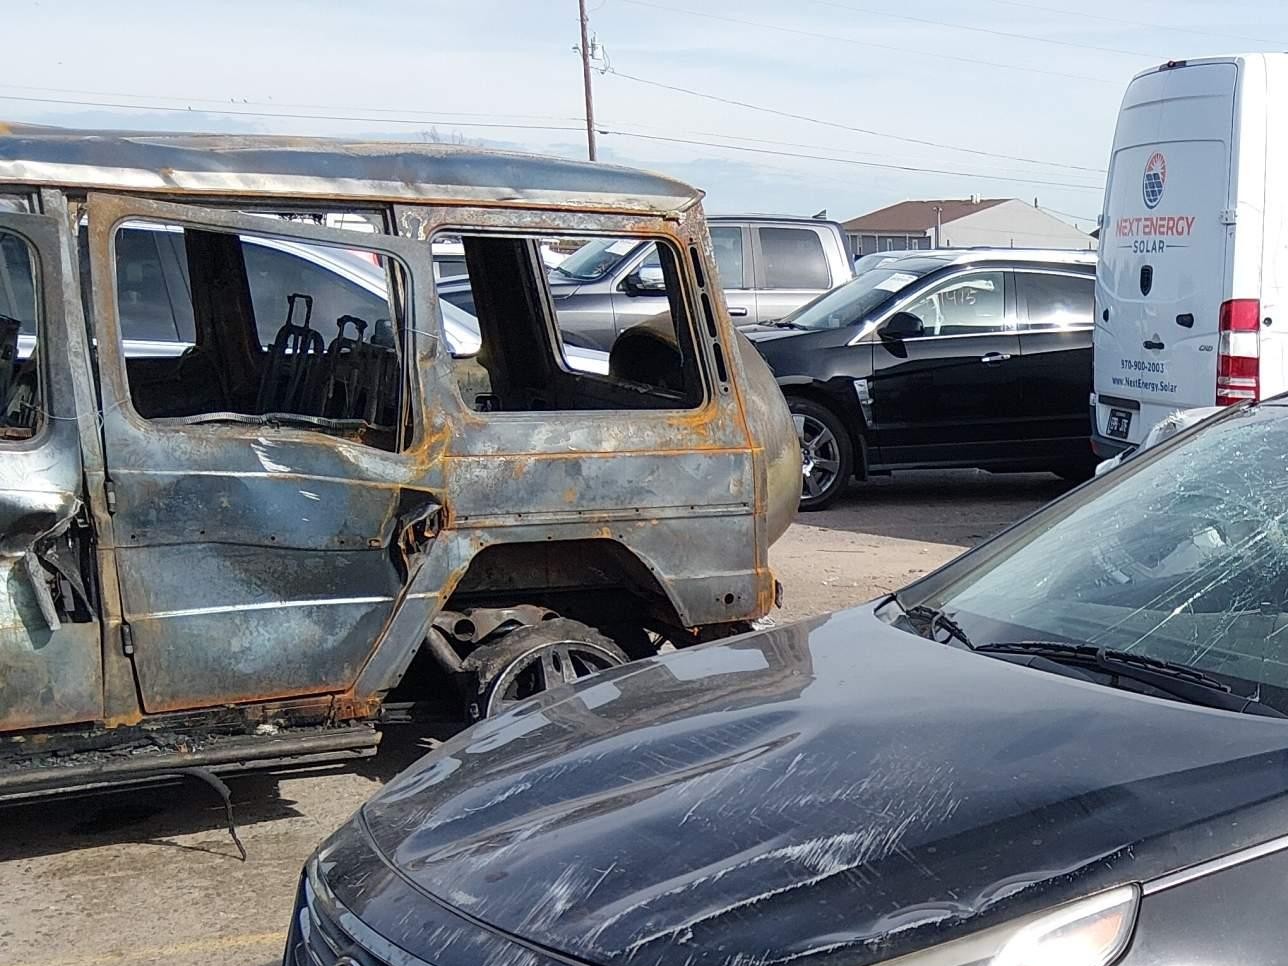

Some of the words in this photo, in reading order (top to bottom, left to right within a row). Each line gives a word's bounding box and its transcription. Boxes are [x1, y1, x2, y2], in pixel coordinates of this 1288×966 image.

[1132, 239, 1166, 254] SOLAR
[1120, 359, 1165, 374] 970-900-2003
[1111, 376, 1178, 394] www.NextEnergy.Solar
